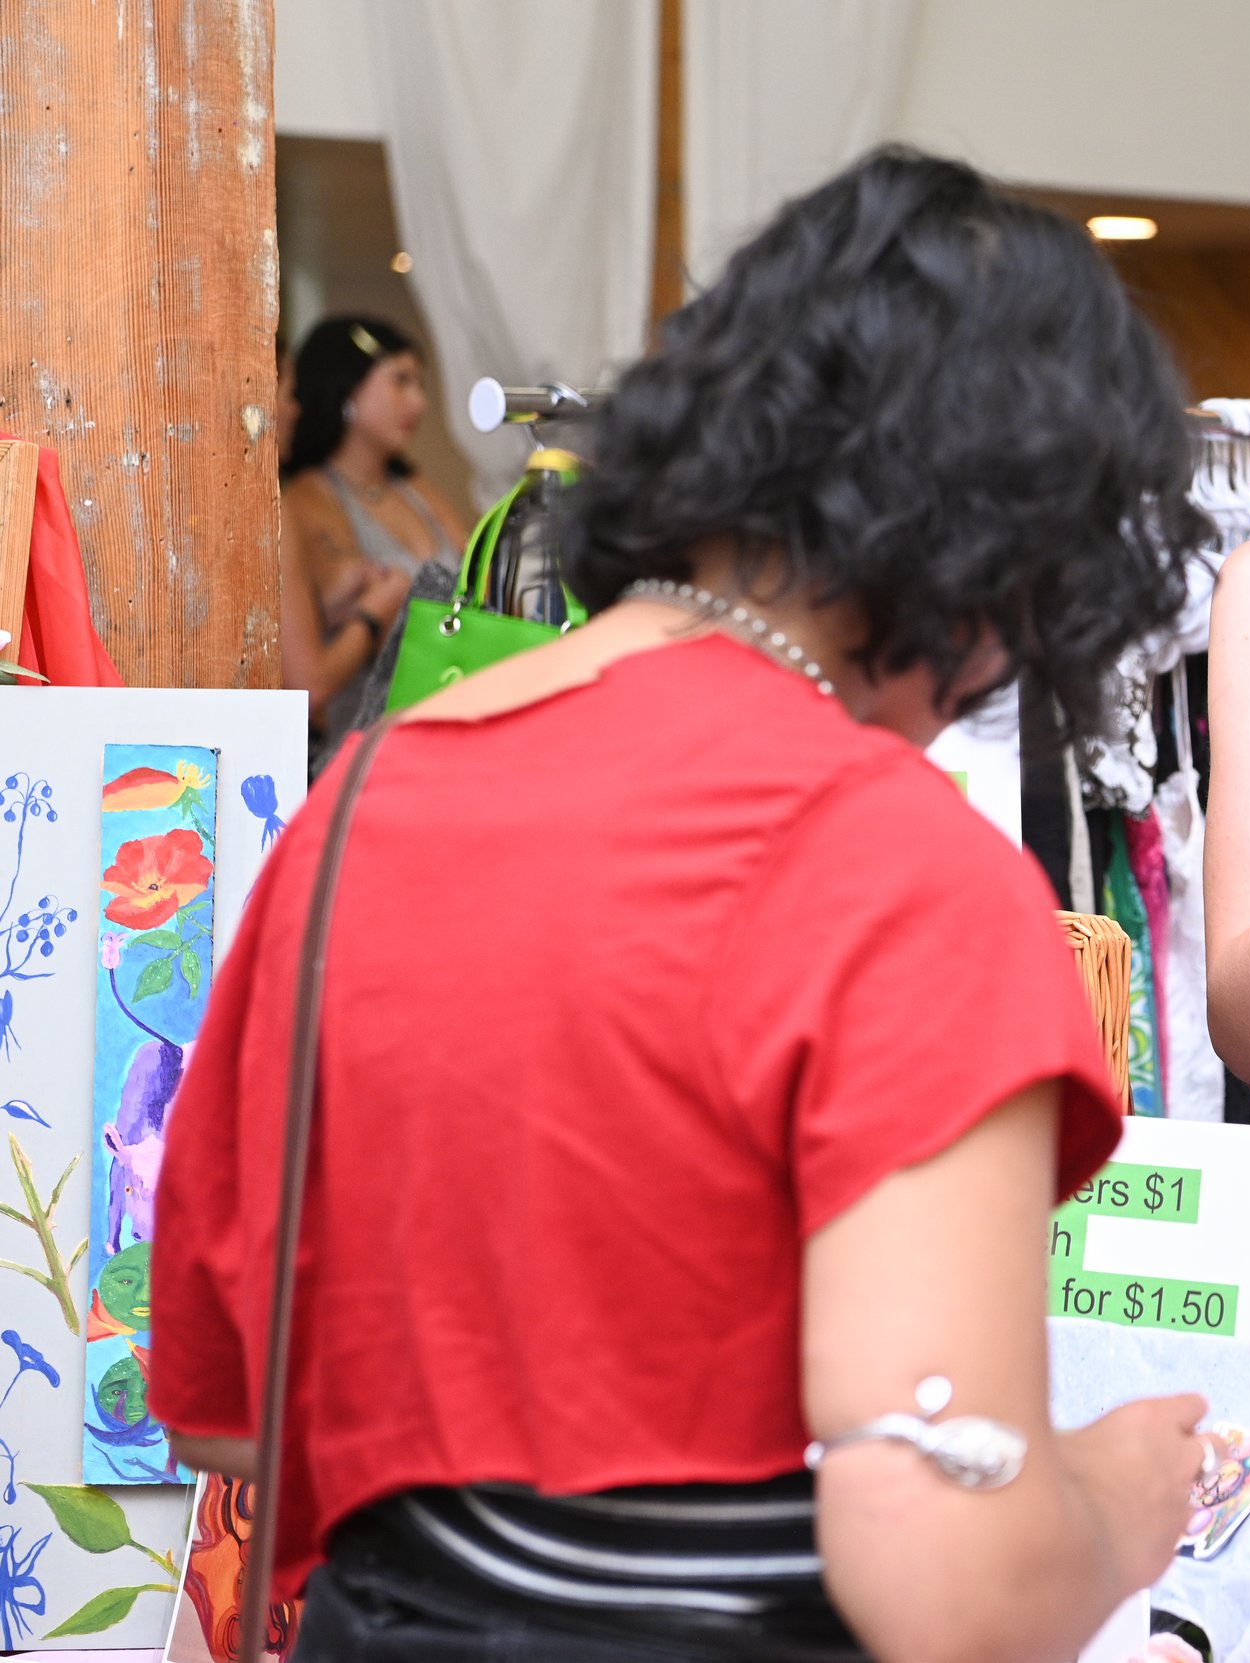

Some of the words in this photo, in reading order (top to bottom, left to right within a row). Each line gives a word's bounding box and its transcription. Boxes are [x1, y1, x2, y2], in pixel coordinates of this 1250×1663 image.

[1067, 1178, 1130, 1207] ers
[1143, 1172, 1184, 1214] $1
[1062, 1278, 1112, 1316] for
[1123, 1281, 1225, 1328] $1.50
